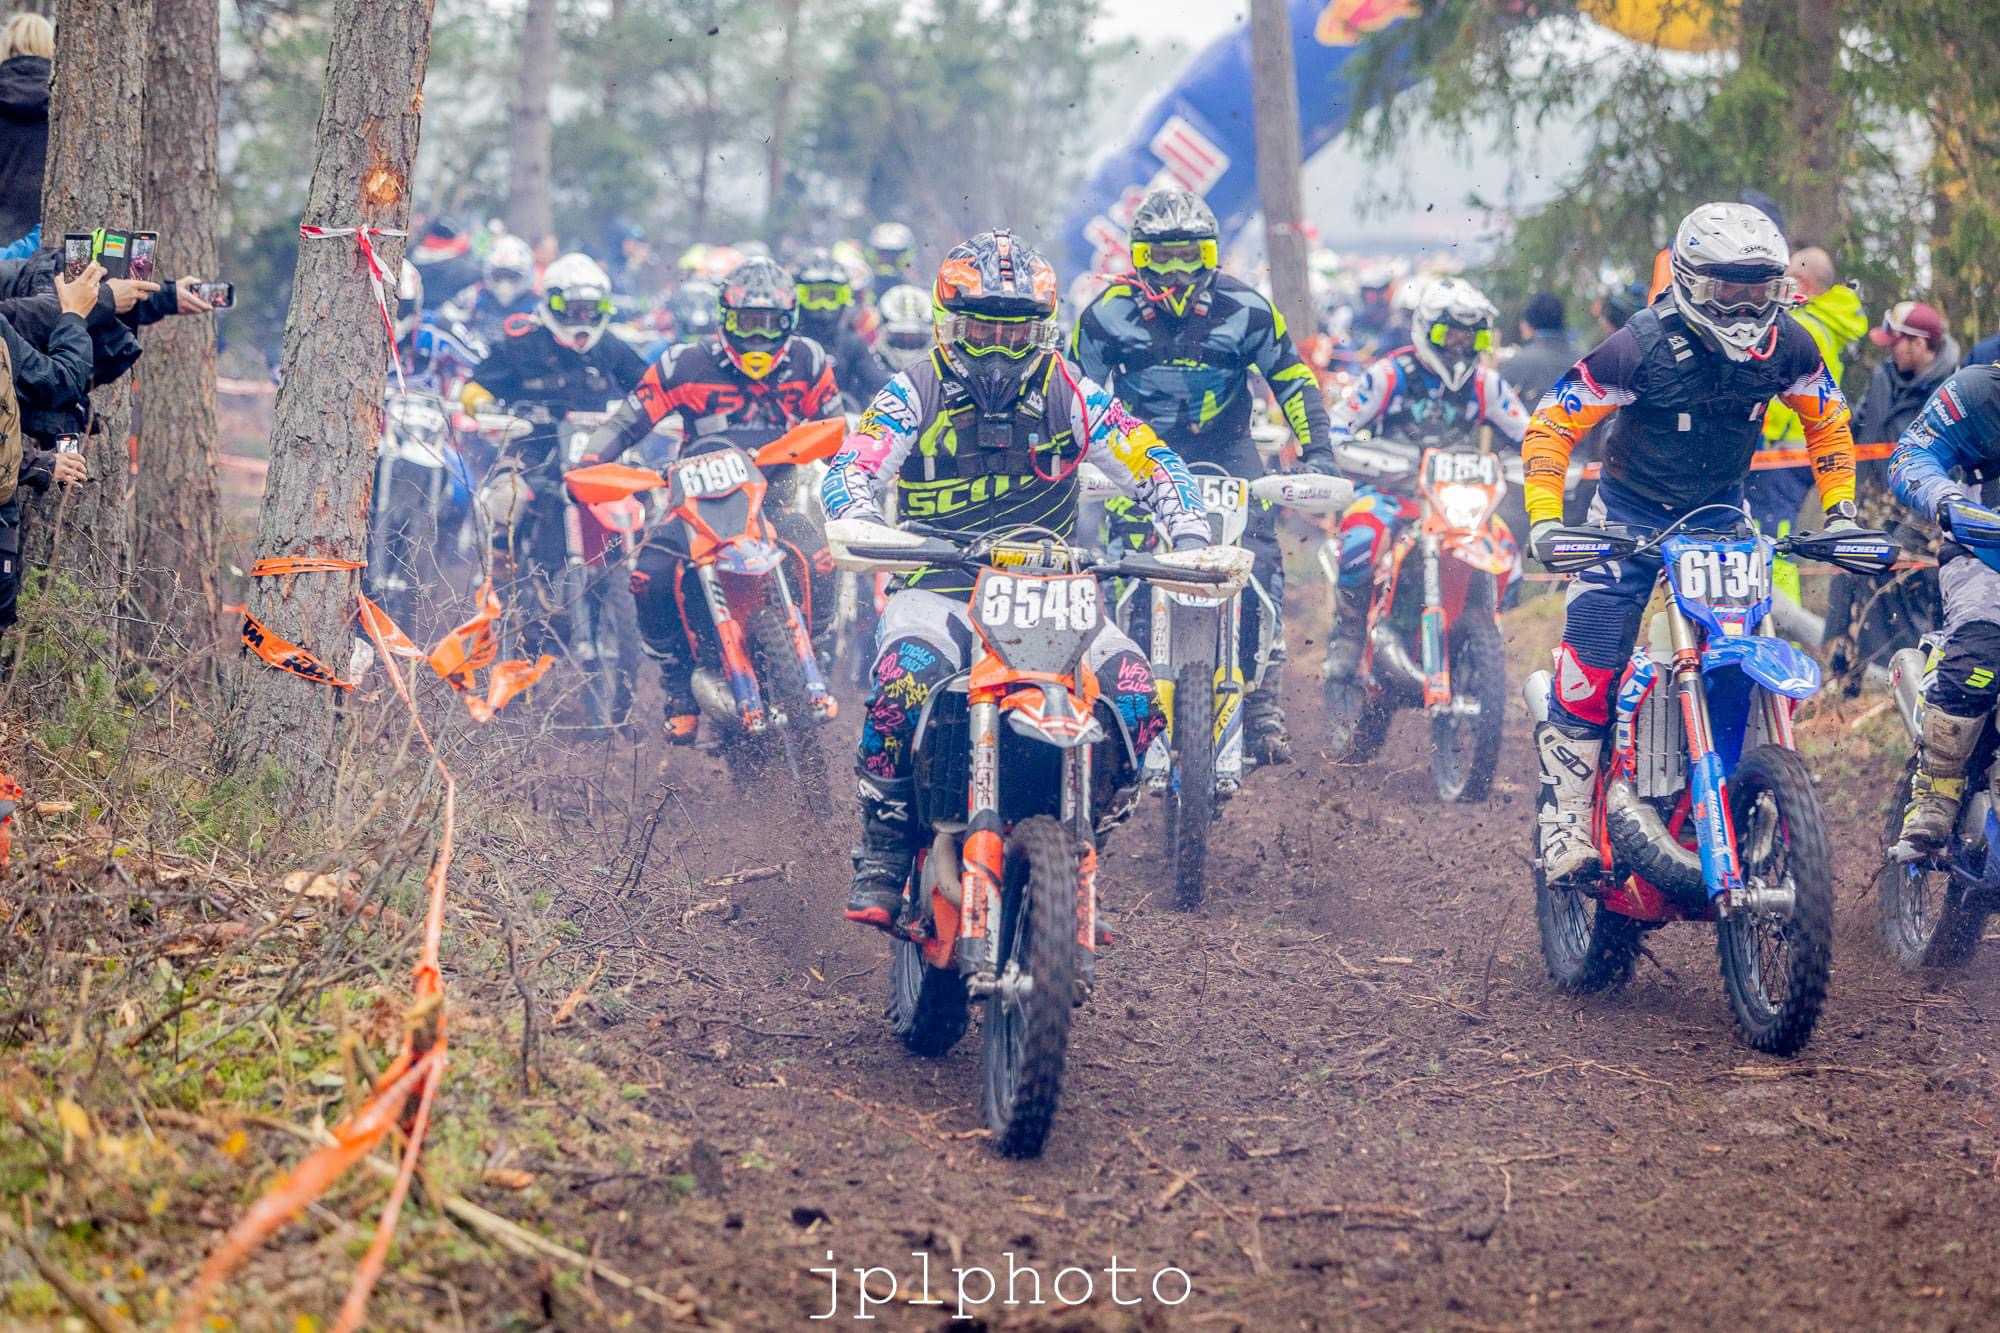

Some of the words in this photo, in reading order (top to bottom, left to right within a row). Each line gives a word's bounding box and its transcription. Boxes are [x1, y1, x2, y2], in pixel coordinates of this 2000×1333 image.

[678, 452, 750, 498] 6190
[1554, 543, 1612, 552] MICHELIN
[1834, 545, 1890, 553] MICHELIN
[1680, 551, 1766, 599] 6134
[982, 576, 1097, 630] 6548
